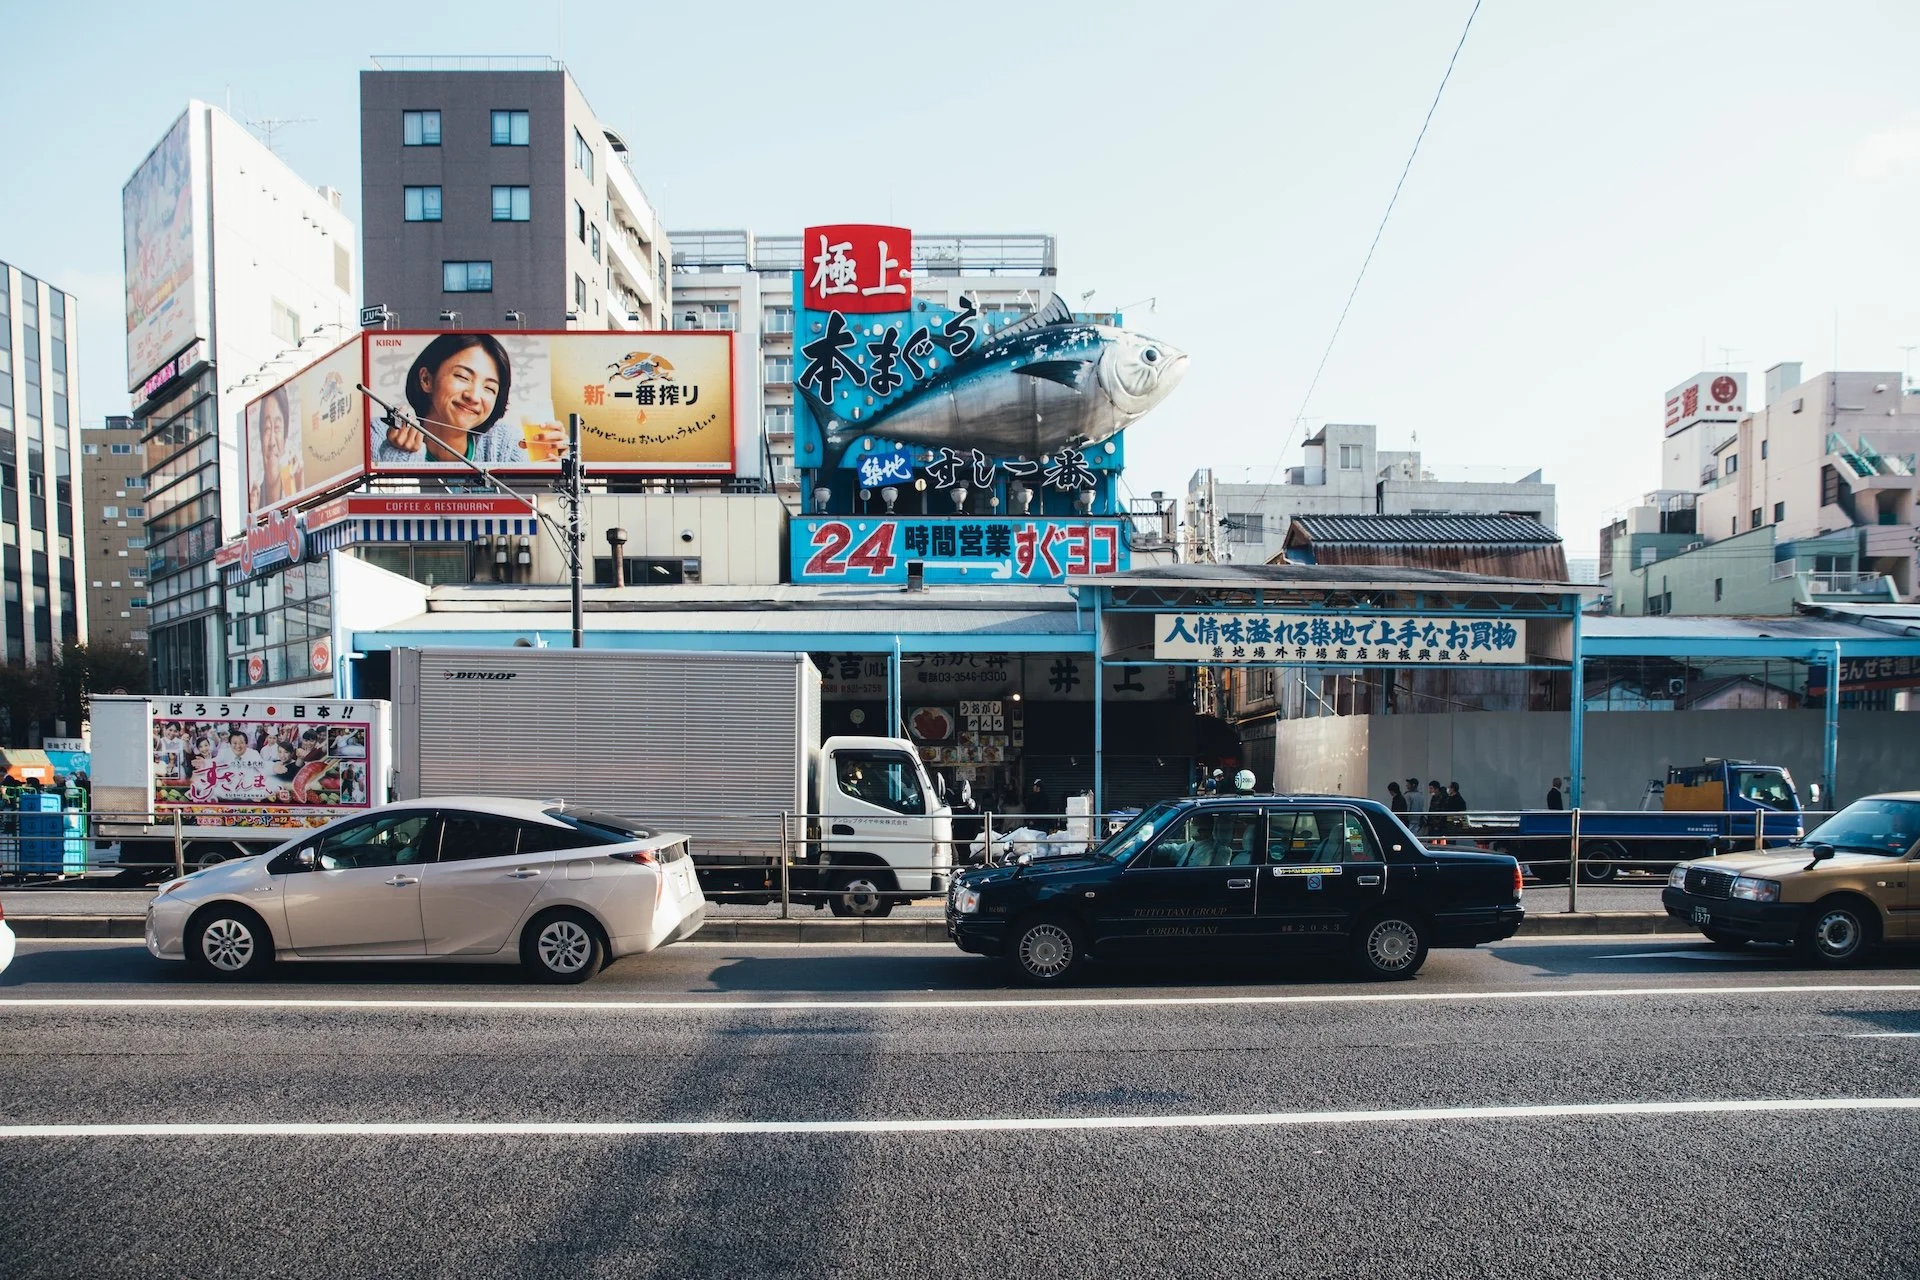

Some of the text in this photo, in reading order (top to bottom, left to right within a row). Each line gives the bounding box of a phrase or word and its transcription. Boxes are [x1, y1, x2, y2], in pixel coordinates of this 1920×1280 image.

[809, 233, 906, 300] 極上
[376, 339, 402, 347] KIRIN
[800, 296, 977, 404] 本まぐろ
[860, 454, 912, 487] 築地
[926, 447, 1097, 490] すし一番
[385, 501, 495, 511] COFFEE & RESTAURANT
[1163, 616, 1518, 651] 人情味溢れる築地で上手なお買物
[1212, 646, 1471, 661] 築地場外市場商店街振興組合
[455, 672, 517, 680] DUNLOP
[960, 702, 1001, 715] うおがし
[832, 817, 909, 826] ダンロップタイヤ中央株式会社
